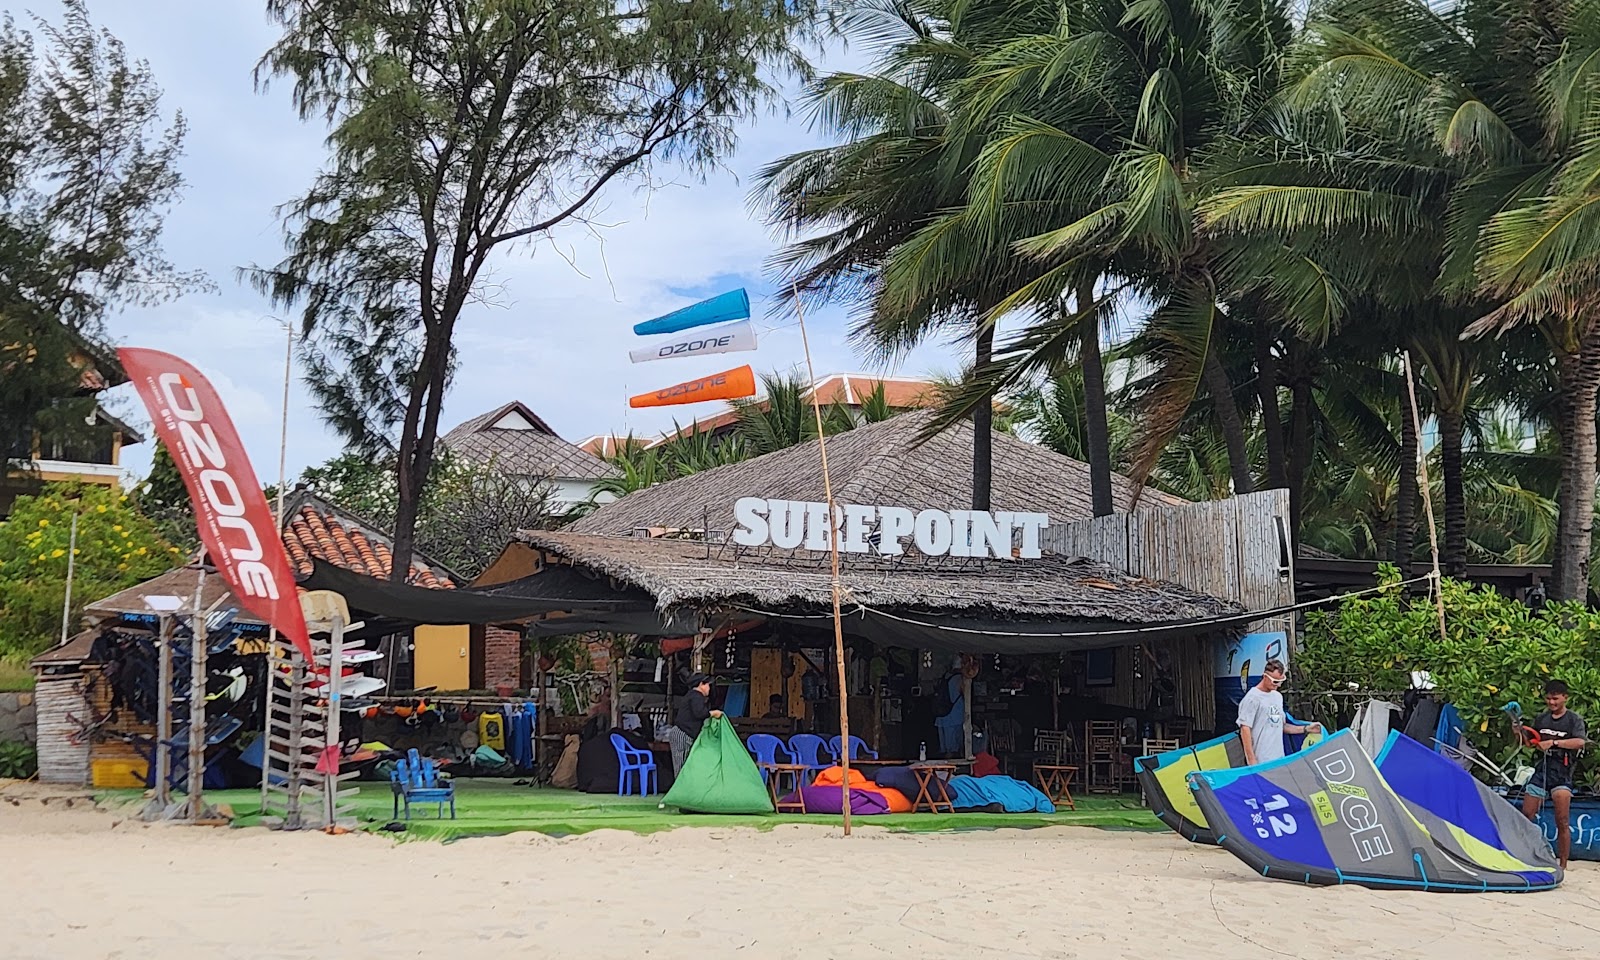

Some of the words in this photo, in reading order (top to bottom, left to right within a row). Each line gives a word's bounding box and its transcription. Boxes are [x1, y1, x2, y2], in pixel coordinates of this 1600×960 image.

[659, 335, 731, 357] OZONE
[656, 374, 727, 400] OZONE
[158, 372, 280, 601] OZONE
[733, 497, 1049, 560] SURFPOINT
[1263, 794, 1298, 838] 12
